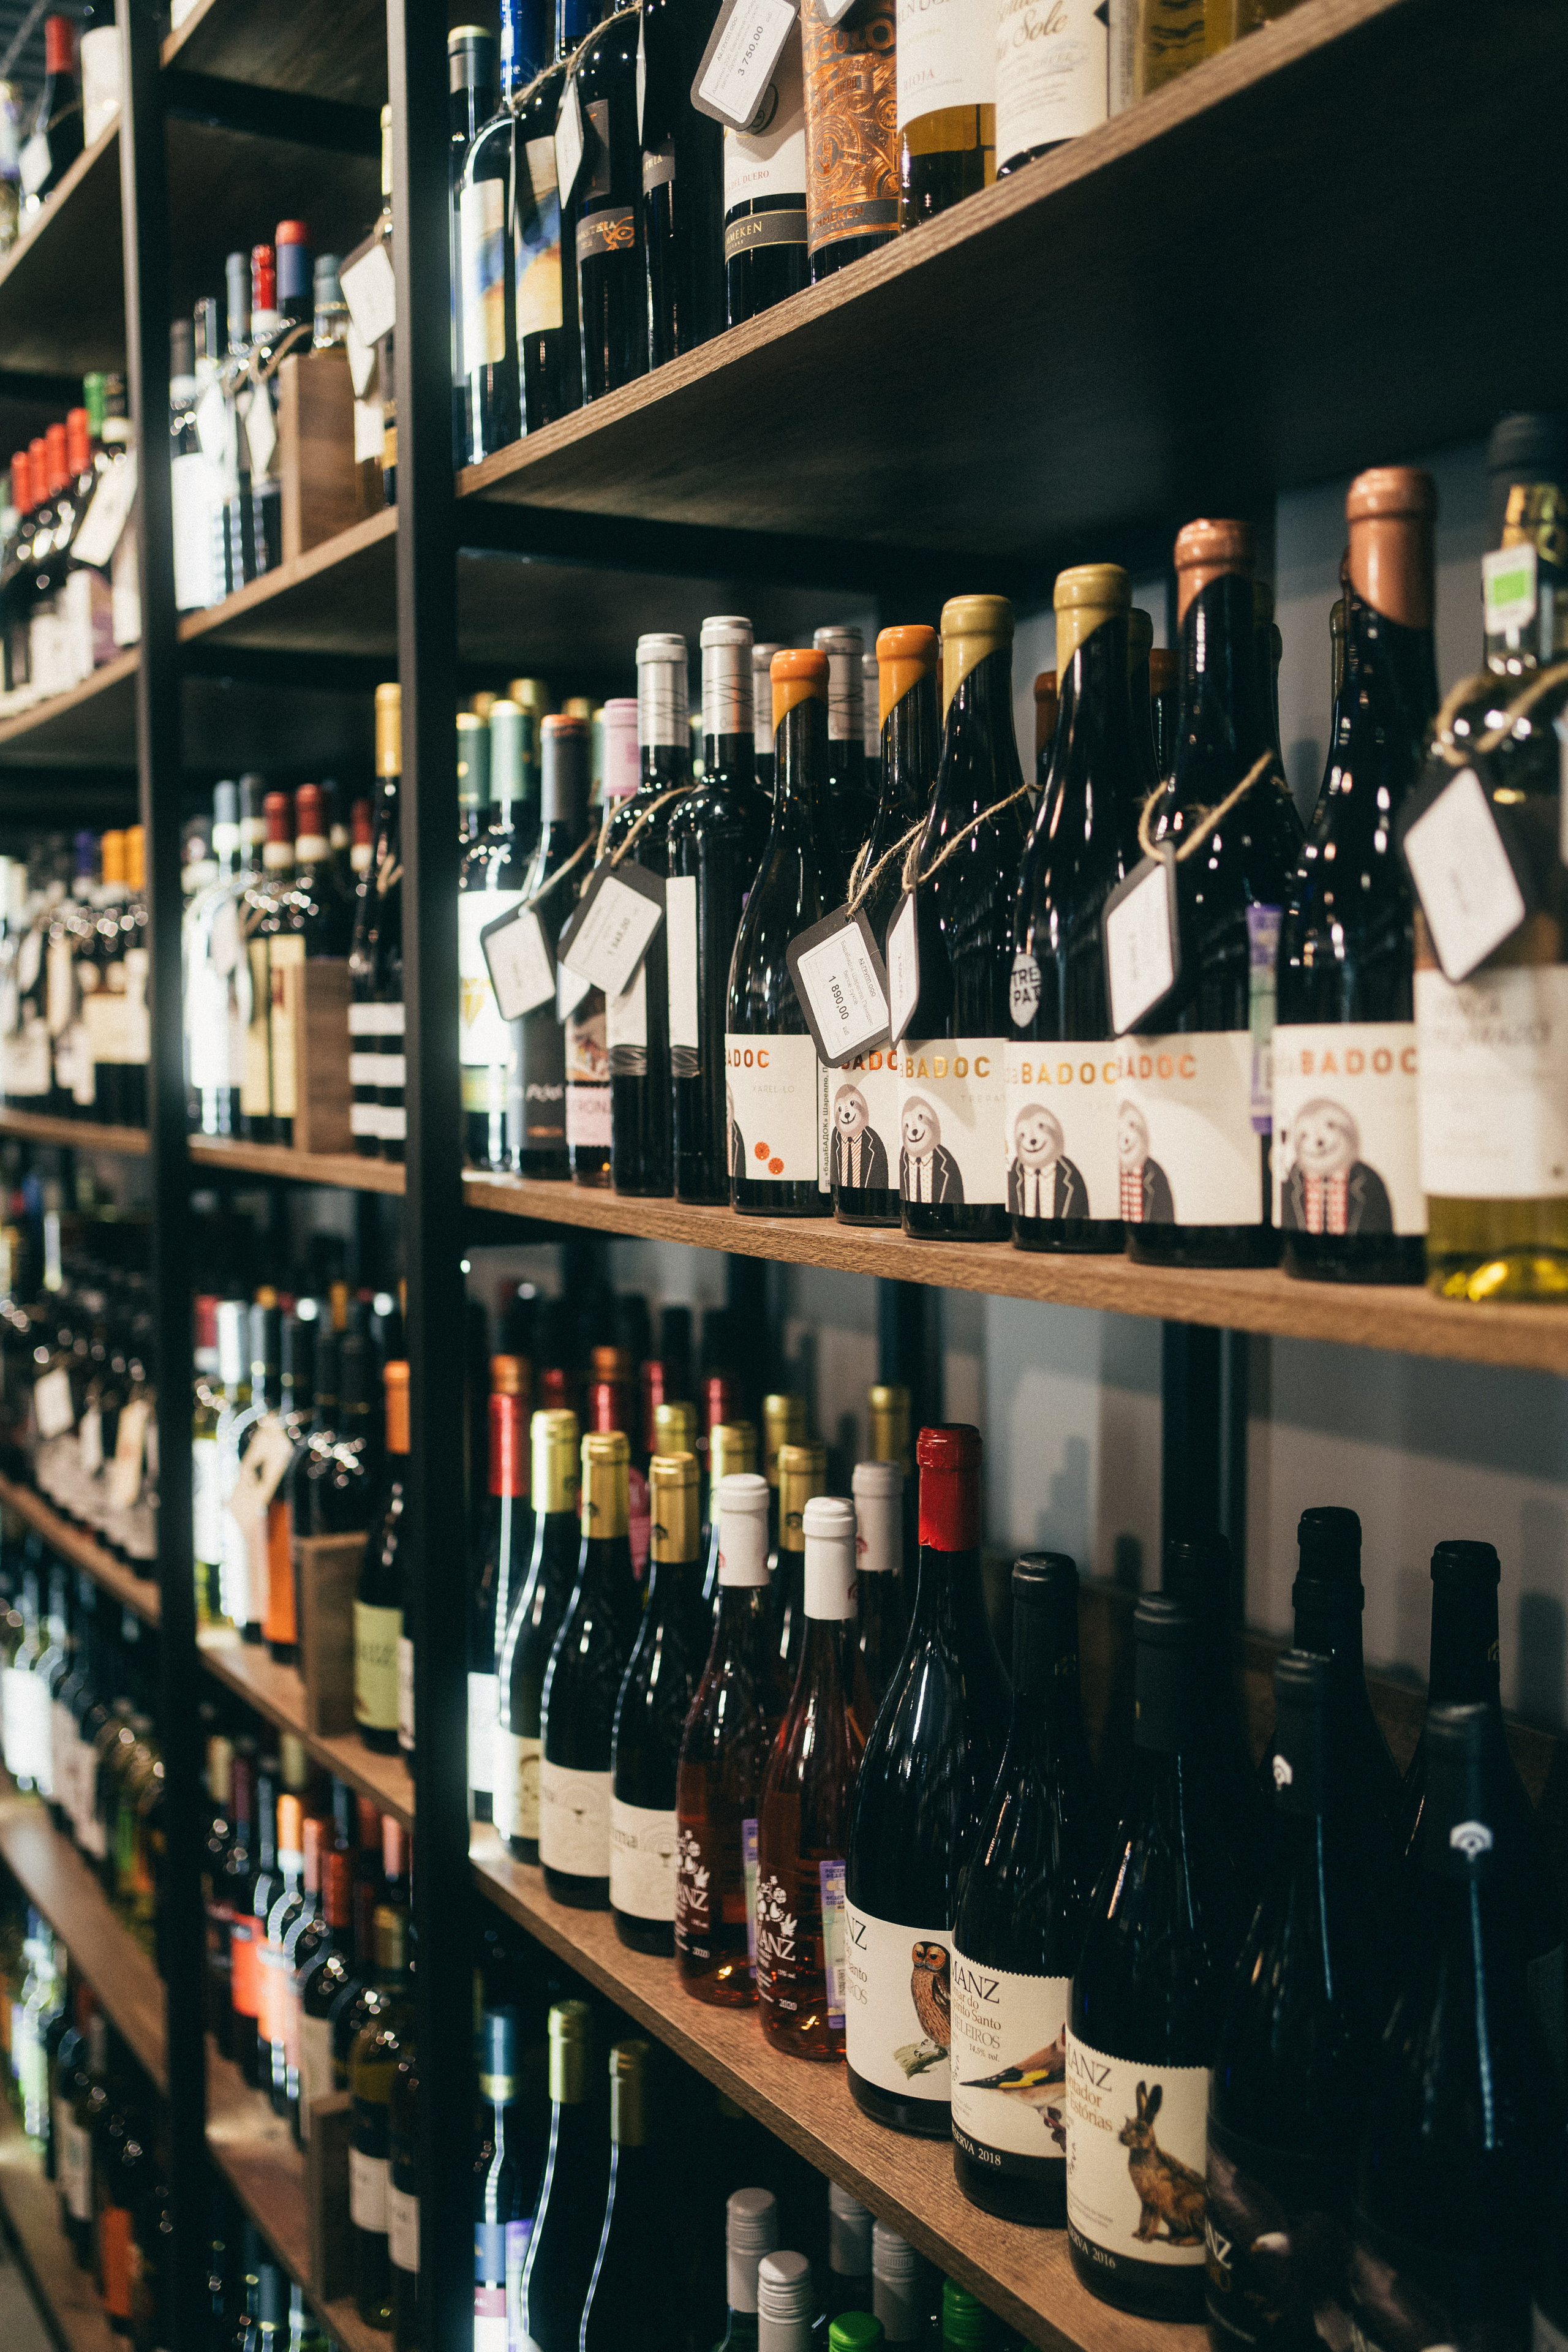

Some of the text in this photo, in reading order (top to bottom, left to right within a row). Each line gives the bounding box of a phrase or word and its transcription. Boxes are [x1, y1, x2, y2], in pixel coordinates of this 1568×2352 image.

[737, 68, 745, 77] 3
[742, 26, 764, 66] 750,00
[743, 170, 770, 183] DUERO
[867, 984, 877, 998] ООО
[829, 984, 850, 1020] 890,00
[967, 1994, 979, 2011] do
[971, 2008, 1001, 2032] Santo
[978, 2147, 1002, 2166] 2018
